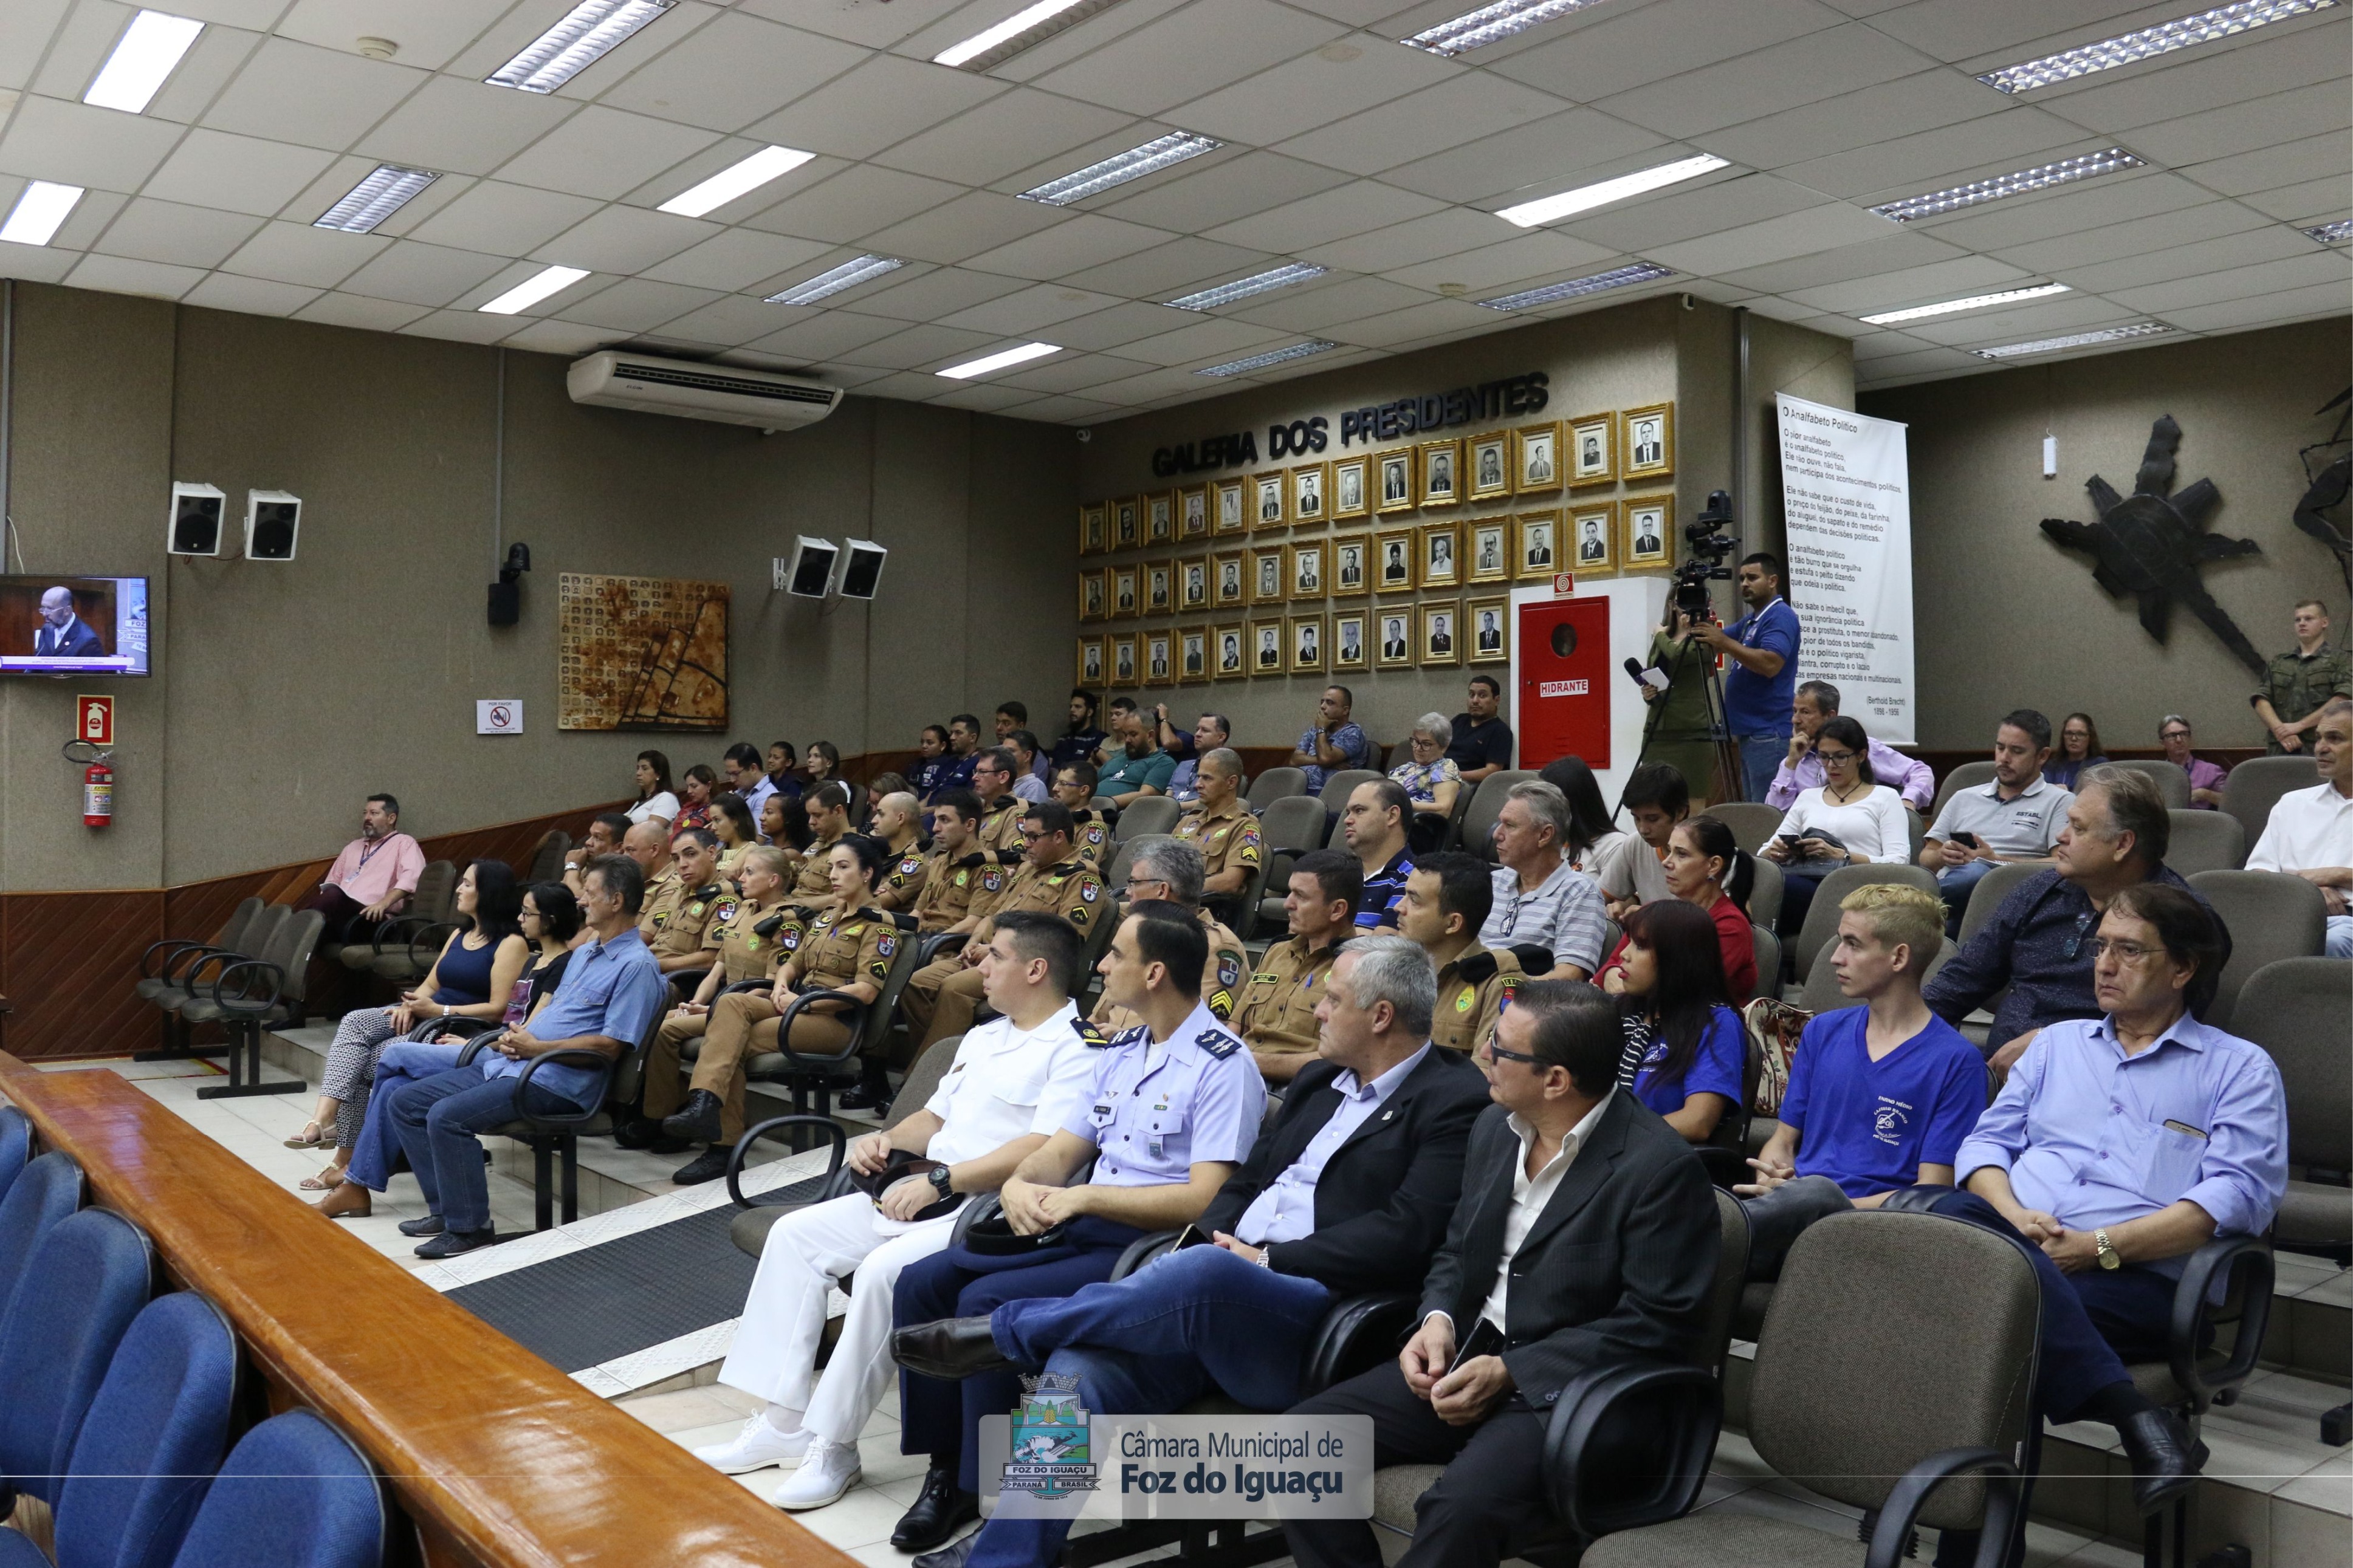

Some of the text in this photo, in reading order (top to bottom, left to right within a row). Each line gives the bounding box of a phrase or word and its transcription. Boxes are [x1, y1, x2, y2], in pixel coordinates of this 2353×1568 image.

[1783, 406, 1788, 416] O
[1791, 409, 1830, 426] Analfabeto
[1152, 372, 1549, 478] GALERIA DOS PRESIDENTES
[1790, 431, 1801, 439] pior
[1803, 435, 1831, 447] analfabeto
[1785, 451, 1794, 460] Ele
[1795, 445, 1822, 456] analfabeto
[1800, 468, 1823, 479] participa
[1836, 475, 1877, 489] acontecimentos
[1787, 485, 1796, 495] Ele
[1798, 488, 1807, 497] não
[1809, 491, 1821, 500] sabe
[1793, 500, 1809, 509] preço
[1788, 521, 1818, 532] dependem
[1819, 526, 1827, 535] das
[1829, 529, 1853, 538] decisões
[1827, 518, 1845, 527] sapato
[1860, 523, 1883, 532] remédio
[1796, 546, 1825, 556] analfabeto
[1806, 556, 1820, 566] burro
[1795, 567, 1813, 576] estufa
[1819, 571, 1833, 580] peito
[1835, 572, 1855, 581] dizendo
[1826, 604, 1844, 614] imbecil
[1815, 614, 1842, 624] ignorância
[1804, 637, 1816, 645] pior
[1839, 673, 1863, 681] nacionais
[1542, 681, 1587, 693] HIDRANTE
[1895, 1101, 1912, 1110] MÉDIO
[1892, 1108, 1908, 1123] BRANCO
